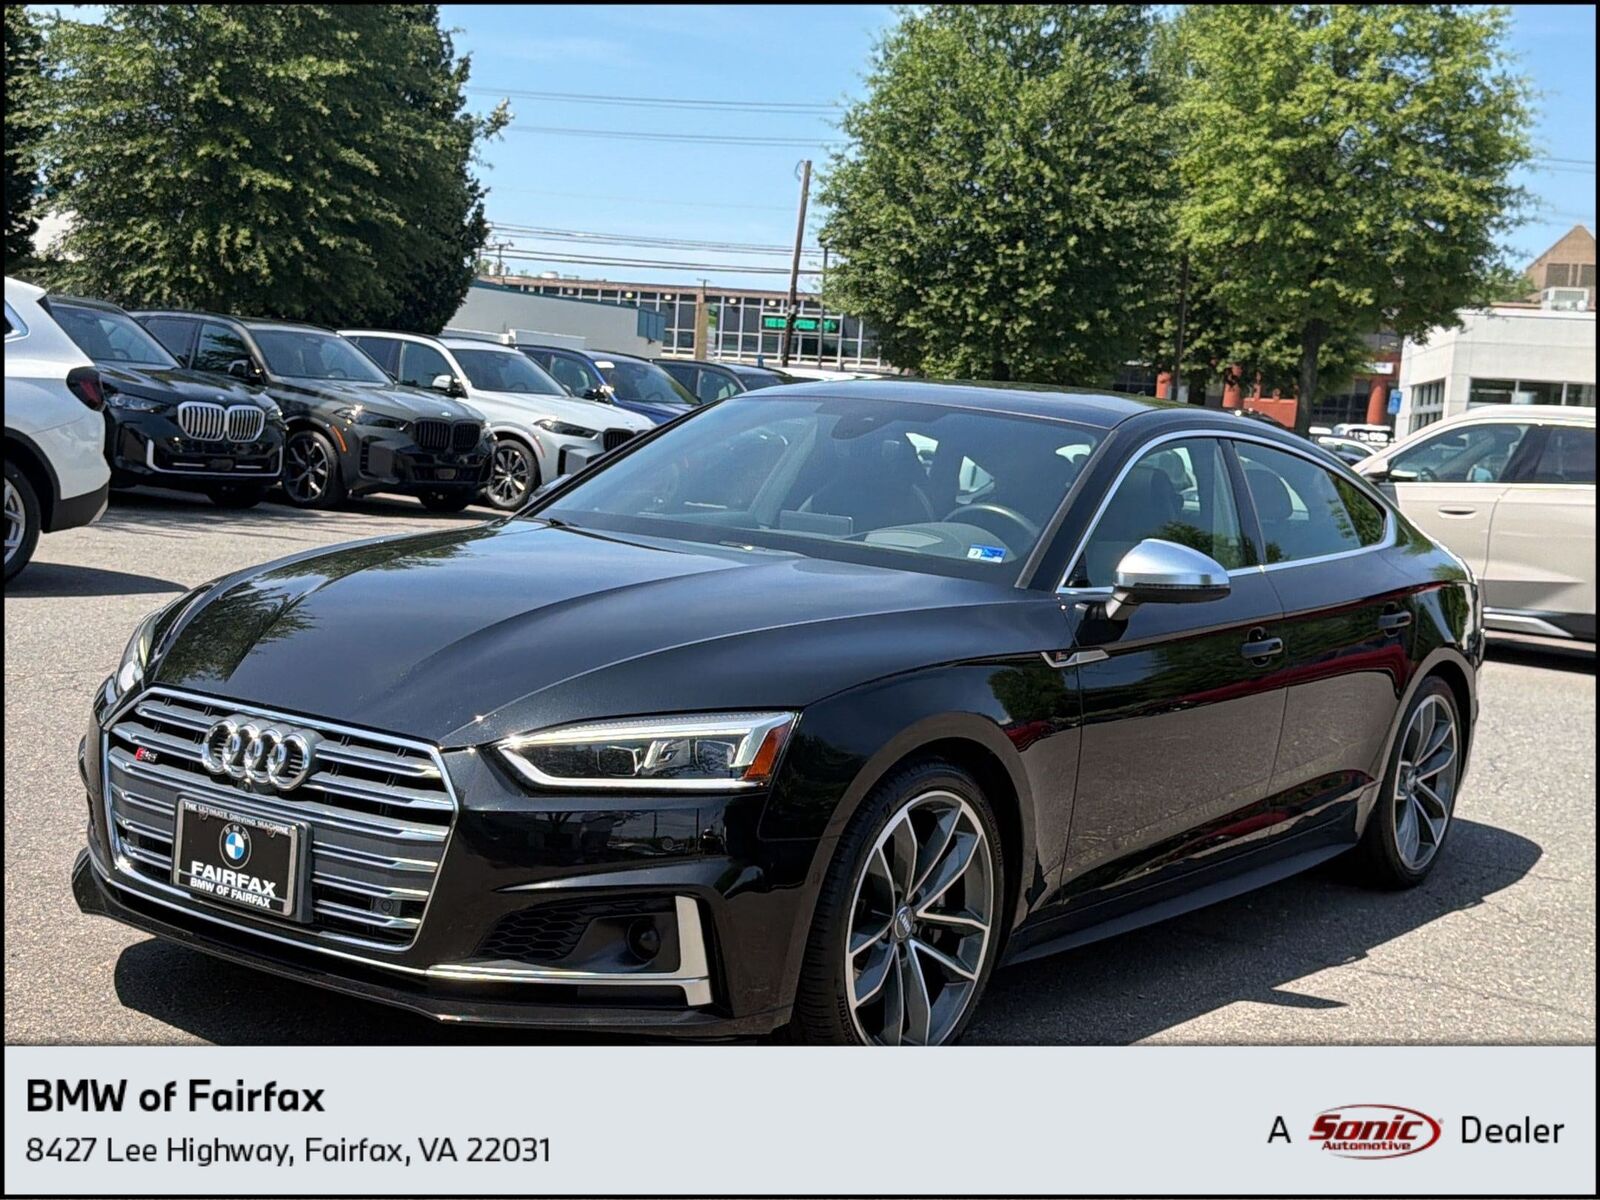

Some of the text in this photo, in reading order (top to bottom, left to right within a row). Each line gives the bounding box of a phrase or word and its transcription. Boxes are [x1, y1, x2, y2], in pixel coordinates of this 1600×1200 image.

[184, 801, 290, 835] THE ULTIMATE DRIVING MACHINE
[190, 877, 271, 908] BMW OF FAIRFAX
[191, 860, 277, 898] FAIRFAX
